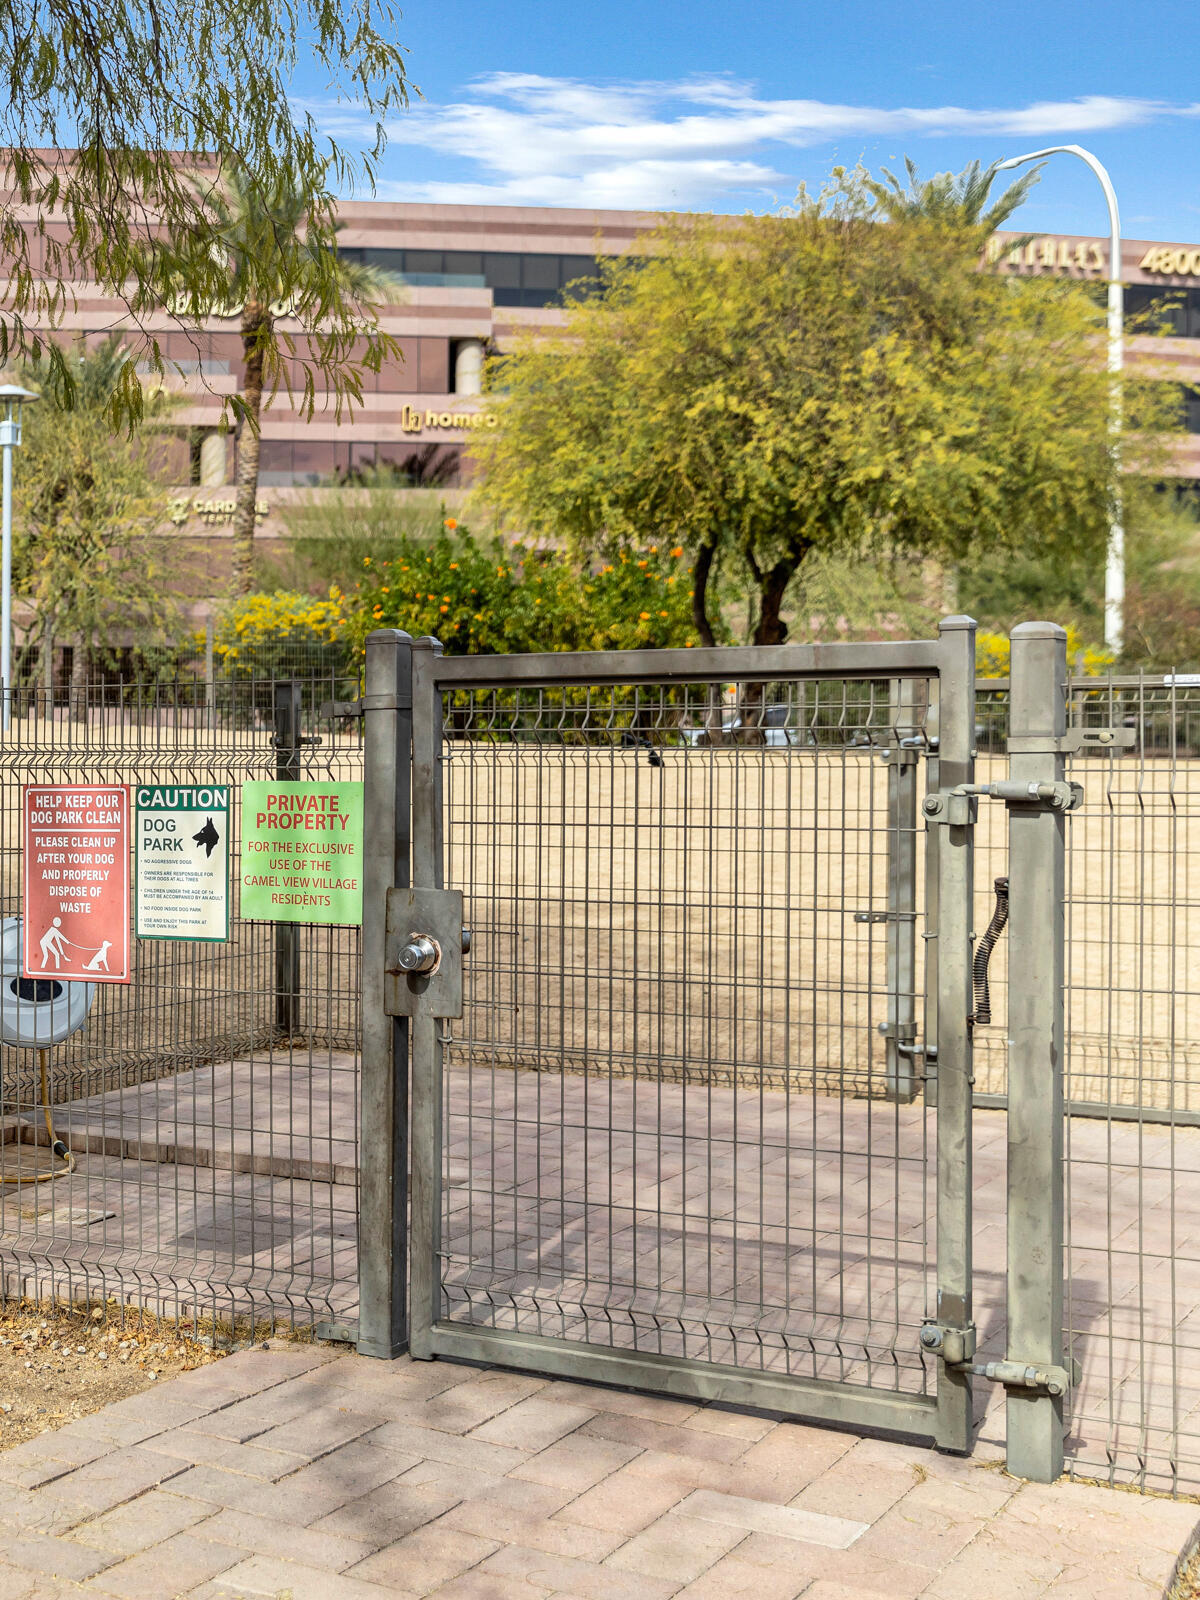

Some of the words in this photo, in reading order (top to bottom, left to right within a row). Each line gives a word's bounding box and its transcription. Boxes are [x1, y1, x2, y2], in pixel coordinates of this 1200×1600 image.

[1139, 246, 1200, 275] 4800
[193, 501, 268, 513] CARDE
[36, 795, 62, 808] HELP
[66, 795, 92, 808] KEEP
[96, 795, 118, 808] OUR
[138, 789, 227, 807] CAUTION
[267, 795, 339, 811] PRIVATE
[31, 811, 52, 824] DOG
[56, 811, 83, 824] PARK
[86, 811, 120, 824] CLEAN
[256, 813, 350, 830] PROPERTY
[144, 819, 176, 832] DOG
[36, 837, 68, 847] PLEASE
[71, 837, 100, 847] CLEAN
[104, 838, 116, 847] UP
[144, 838, 183, 851] PARK
[248, 841, 269, 852] FOR
[272, 842, 292, 852] THE
[296, 843, 354, 854] EXCLUSIVE
[37, 853, 65, 863] AFTER
[68, 853, 92, 864] YOUR
[95, 854, 114, 864] DOG
[270, 859, 290, 870] USE
[293, 860, 307, 870] OF
[310, 860, 331, 871] THE
[42, 870, 60, 879] AND
[63, 870, 109, 880] PROPERLY
[244, 875, 280, 886] CAMEL
[283, 876, 310, 888] VIEW
[312, 878, 357, 889] VILLAGE
[50, 886, 87, 896] DISPOSE
[90, 887, 102, 897] OF
[272, 893, 330, 906] RESIDENTS
[60, 902, 91, 913] WASTE
